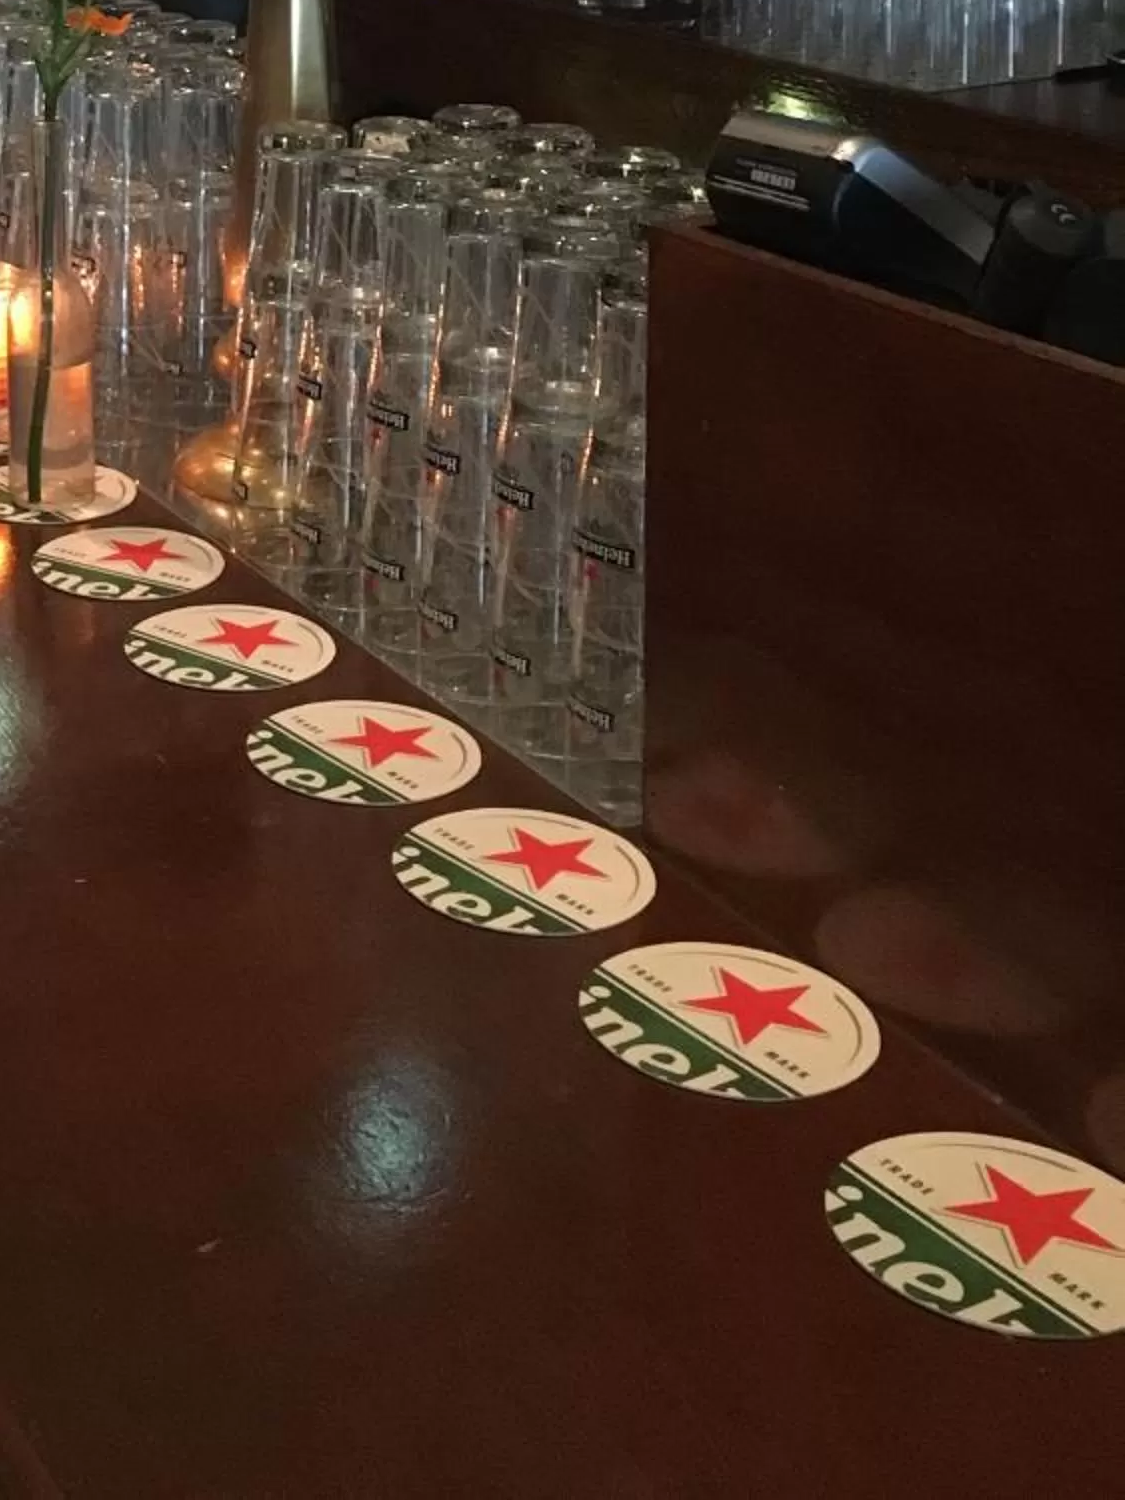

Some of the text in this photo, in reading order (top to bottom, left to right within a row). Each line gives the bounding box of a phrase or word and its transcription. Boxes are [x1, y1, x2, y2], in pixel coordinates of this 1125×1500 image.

[627, 963, 673, 994] TRADE
[764, 1051, 811, 1080] MARK
[879, 1157, 935, 1196] TRADE
[1047, 1272, 1106, 1311] MARK
